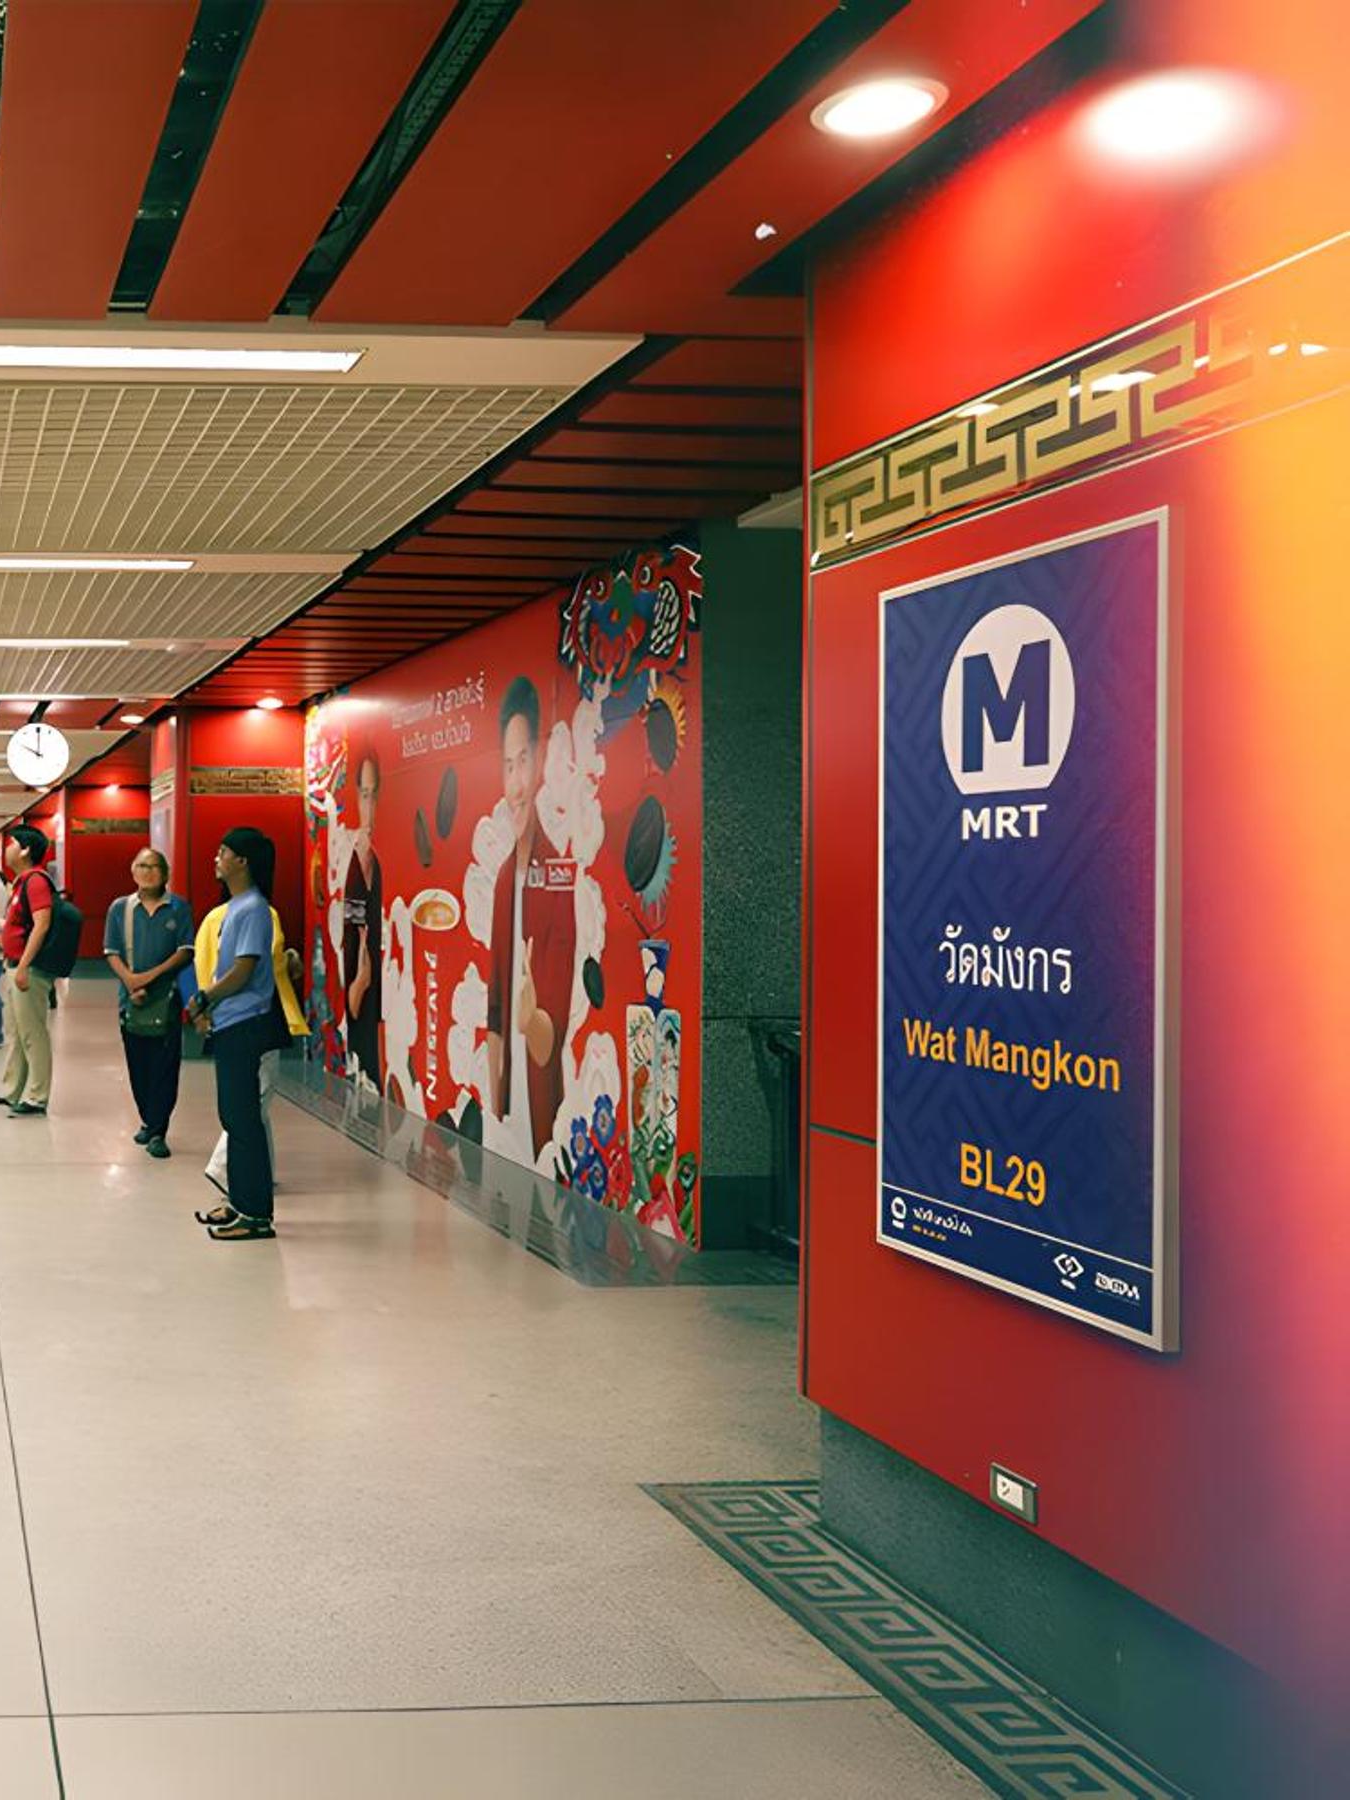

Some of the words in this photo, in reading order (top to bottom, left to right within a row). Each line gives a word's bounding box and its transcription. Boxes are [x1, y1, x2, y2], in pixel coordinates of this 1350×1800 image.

[961, 804, 1048, 841] MRT
[938, 923, 1072, 995] วัดมังกร
[903, 1017, 957, 1064] Wat
[965, 1026, 1121, 1092] Mangkon
[960, 1142, 1047, 1208] BL29
